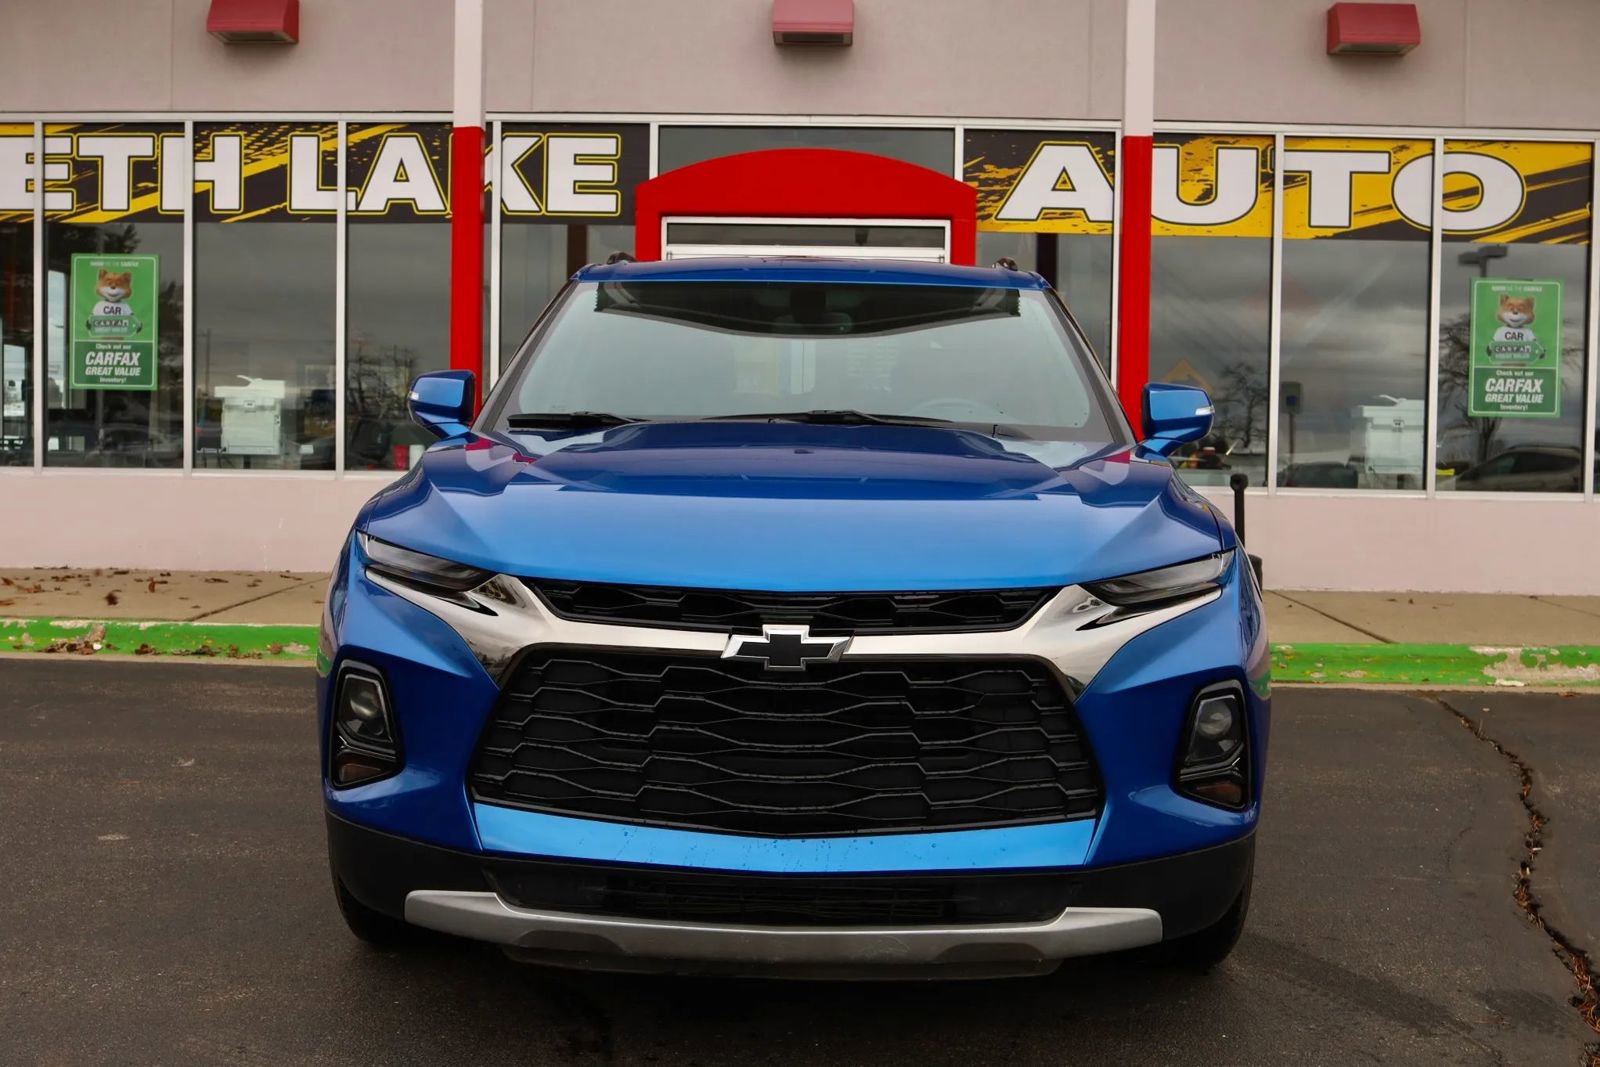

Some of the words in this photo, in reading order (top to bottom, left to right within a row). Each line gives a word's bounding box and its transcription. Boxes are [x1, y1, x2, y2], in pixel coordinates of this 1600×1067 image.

[288, 132, 621, 216] LAKE
[994, 140, 1527, 235] AUTO
[103, 306, 122, 315] CAR
[1504, 331, 1524, 340] CAR
[85, 351, 141, 366] CARFAX
[85, 366, 113, 376] GREAT
[114, 367, 141, 376] VALUE
[1485, 377, 1543, 393] CARFAX
[1485, 393, 1514, 403] GREAT
[1515, 393, 1544, 404] VALUE
